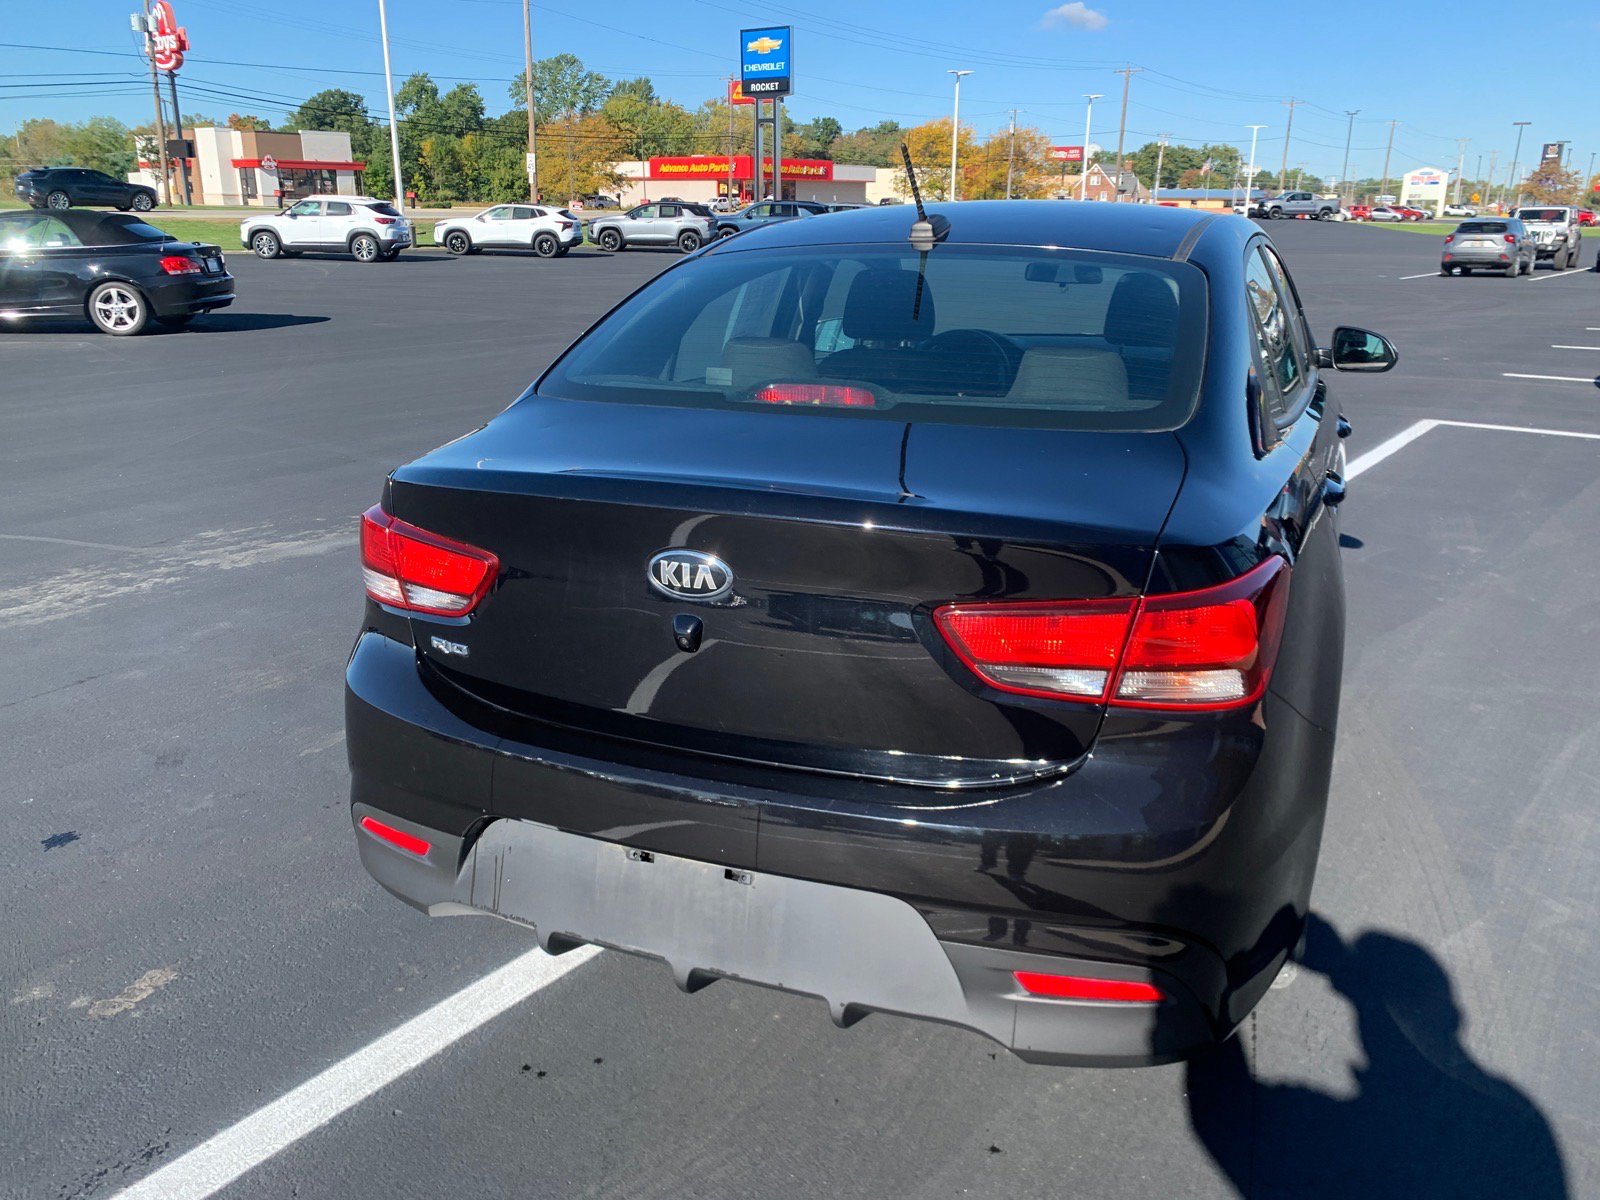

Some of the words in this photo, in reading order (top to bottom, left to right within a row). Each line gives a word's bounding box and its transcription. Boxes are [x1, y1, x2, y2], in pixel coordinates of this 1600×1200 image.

[744, 61, 786, 72] CHEVROLET
[750, 82, 780, 92] ROCKET
[659, 163, 689, 173] Advance
[689, 162, 709, 173] Auto
[708, 162, 730, 173] Parts
[660, 559, 717, 590] KIA
